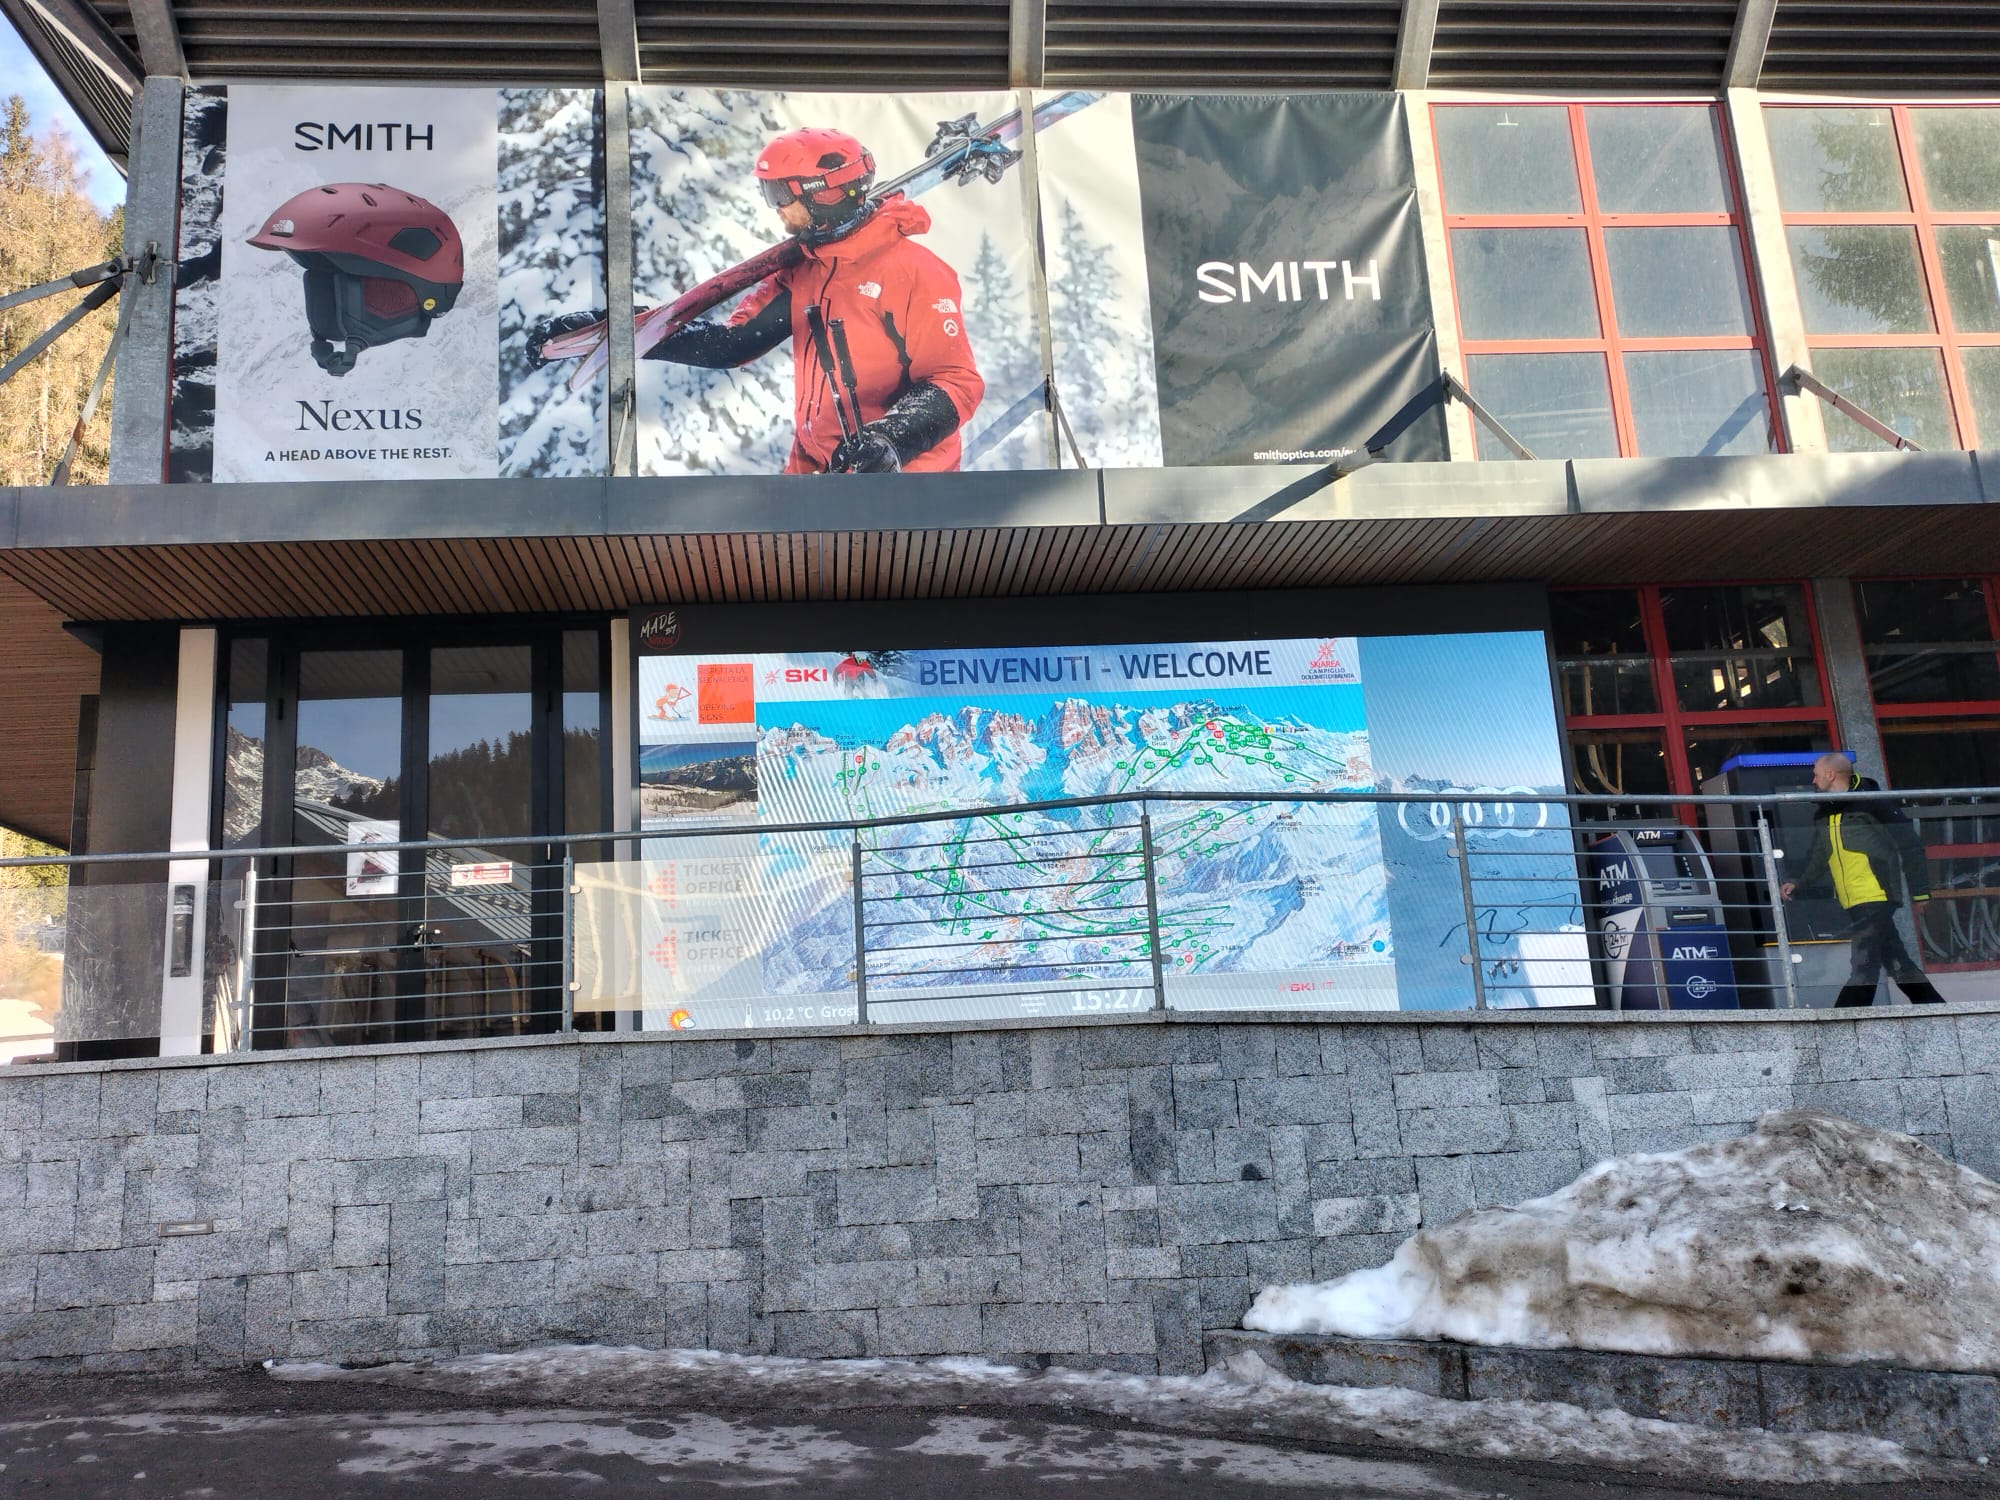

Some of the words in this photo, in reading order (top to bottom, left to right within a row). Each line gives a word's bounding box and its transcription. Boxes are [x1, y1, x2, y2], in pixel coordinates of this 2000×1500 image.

[294, 121, 433, 151] SMITH
[802, 180, 826, 191] SMITH
[1196, 259, 1382, 304] SMITH
[295, 399, 423, 431] Nexus
[264, 450, 275, 462] A
[279, 449, 321, 461] HEAD
[324, 448, 377, 460] ABOVE
[380, 448, 409, 459] THE
[413, 446, 452, 459] REST.
[640, 610, 677, 639] MADE
[784, 668, 828, 683] SKI
[919, 655, 1092, 686] BENVENUTI
[1119, 650, 1273, 680] WELCOME
[1308, 667, 1346, 675] CAMPIGLIO
[699, 713, 724, 721] SIGNS
[1636, 830, 1661, 841] ATM
[683, 863, 742, 877] TICKET
[1599, 860, 1628, 891] ATM
[685, 880, 746, 894] OFFICE
[684, 929, 742, 944] TICKET
[1609, 934, 1619, 946] 24
[687, 947, 746, 961] OFFICE
[1672, 946, 1708, 960] ATM
[1070, 988, 1145, 1011] 15:27
[764, 1008, 795, 1023] 10,2
